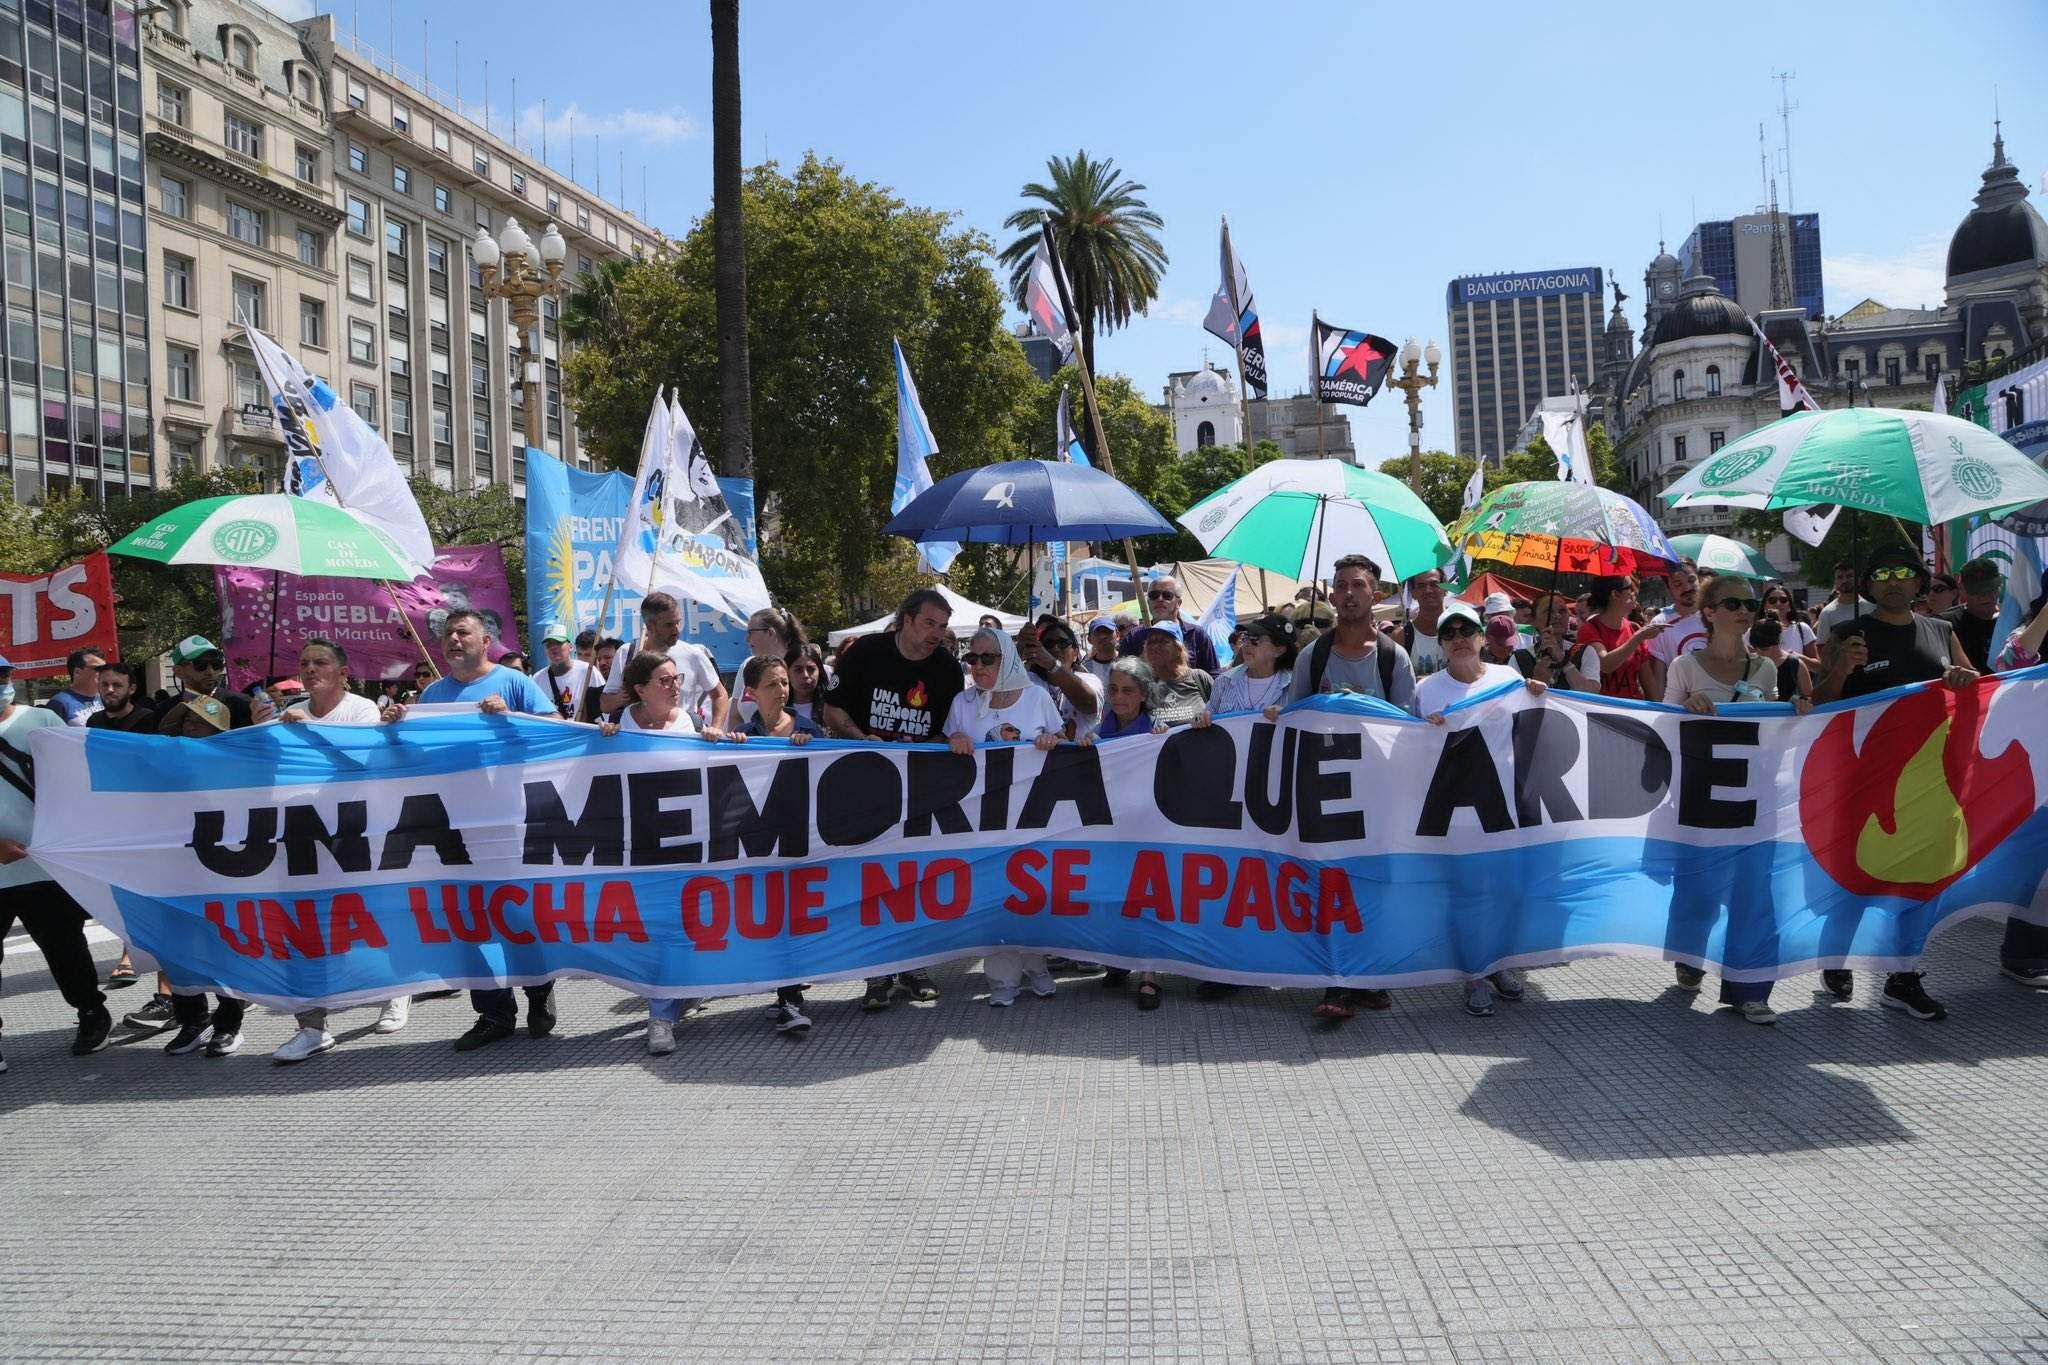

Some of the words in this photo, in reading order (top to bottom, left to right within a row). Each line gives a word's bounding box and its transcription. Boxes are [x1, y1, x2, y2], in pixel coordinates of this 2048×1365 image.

[1467, 273, 1590, 297] BANCOPATAGONIA
[1331, 391, 1365, 402] POPULAR
[1835, 477, 1862, 488] DE
[1806, 480, 1887, 507] MONEDA
[571, 516, 624, 543] FRENT
[328, 540, 358, 551] CASA
[340, 549, 357, 559] DE
[325, 558, 381, 569] MONEDA
[295, 590, 344, 603] Espacio
[296, 605, 404, 625] PUEBLA
[299, 627, 329, 640] San
[335, 627, 392, 641] Martín
[873, 688, 900, 706] UNA
[870, 701, 932, 724] MEMORIA
[869, 715, 894, 731] QUE
[898, 720, 931, 736] ARDE
[186, 793, 473, 877] UNA
[522, 745, 1113, 866] MEMORIA
[1153, 722, 1366, 843] QUE
[1415, 707, 1760, 837] ARDE
[204, 892, 388, 960] UNA
[407, 880, 649, 945] LUCHA
[681, 867, 829, 951] QUE
[861, 857, 972, 927] NO
[1003, 848, 1091, 916] SE
[1120, 850, 1364, 935] APAGA
